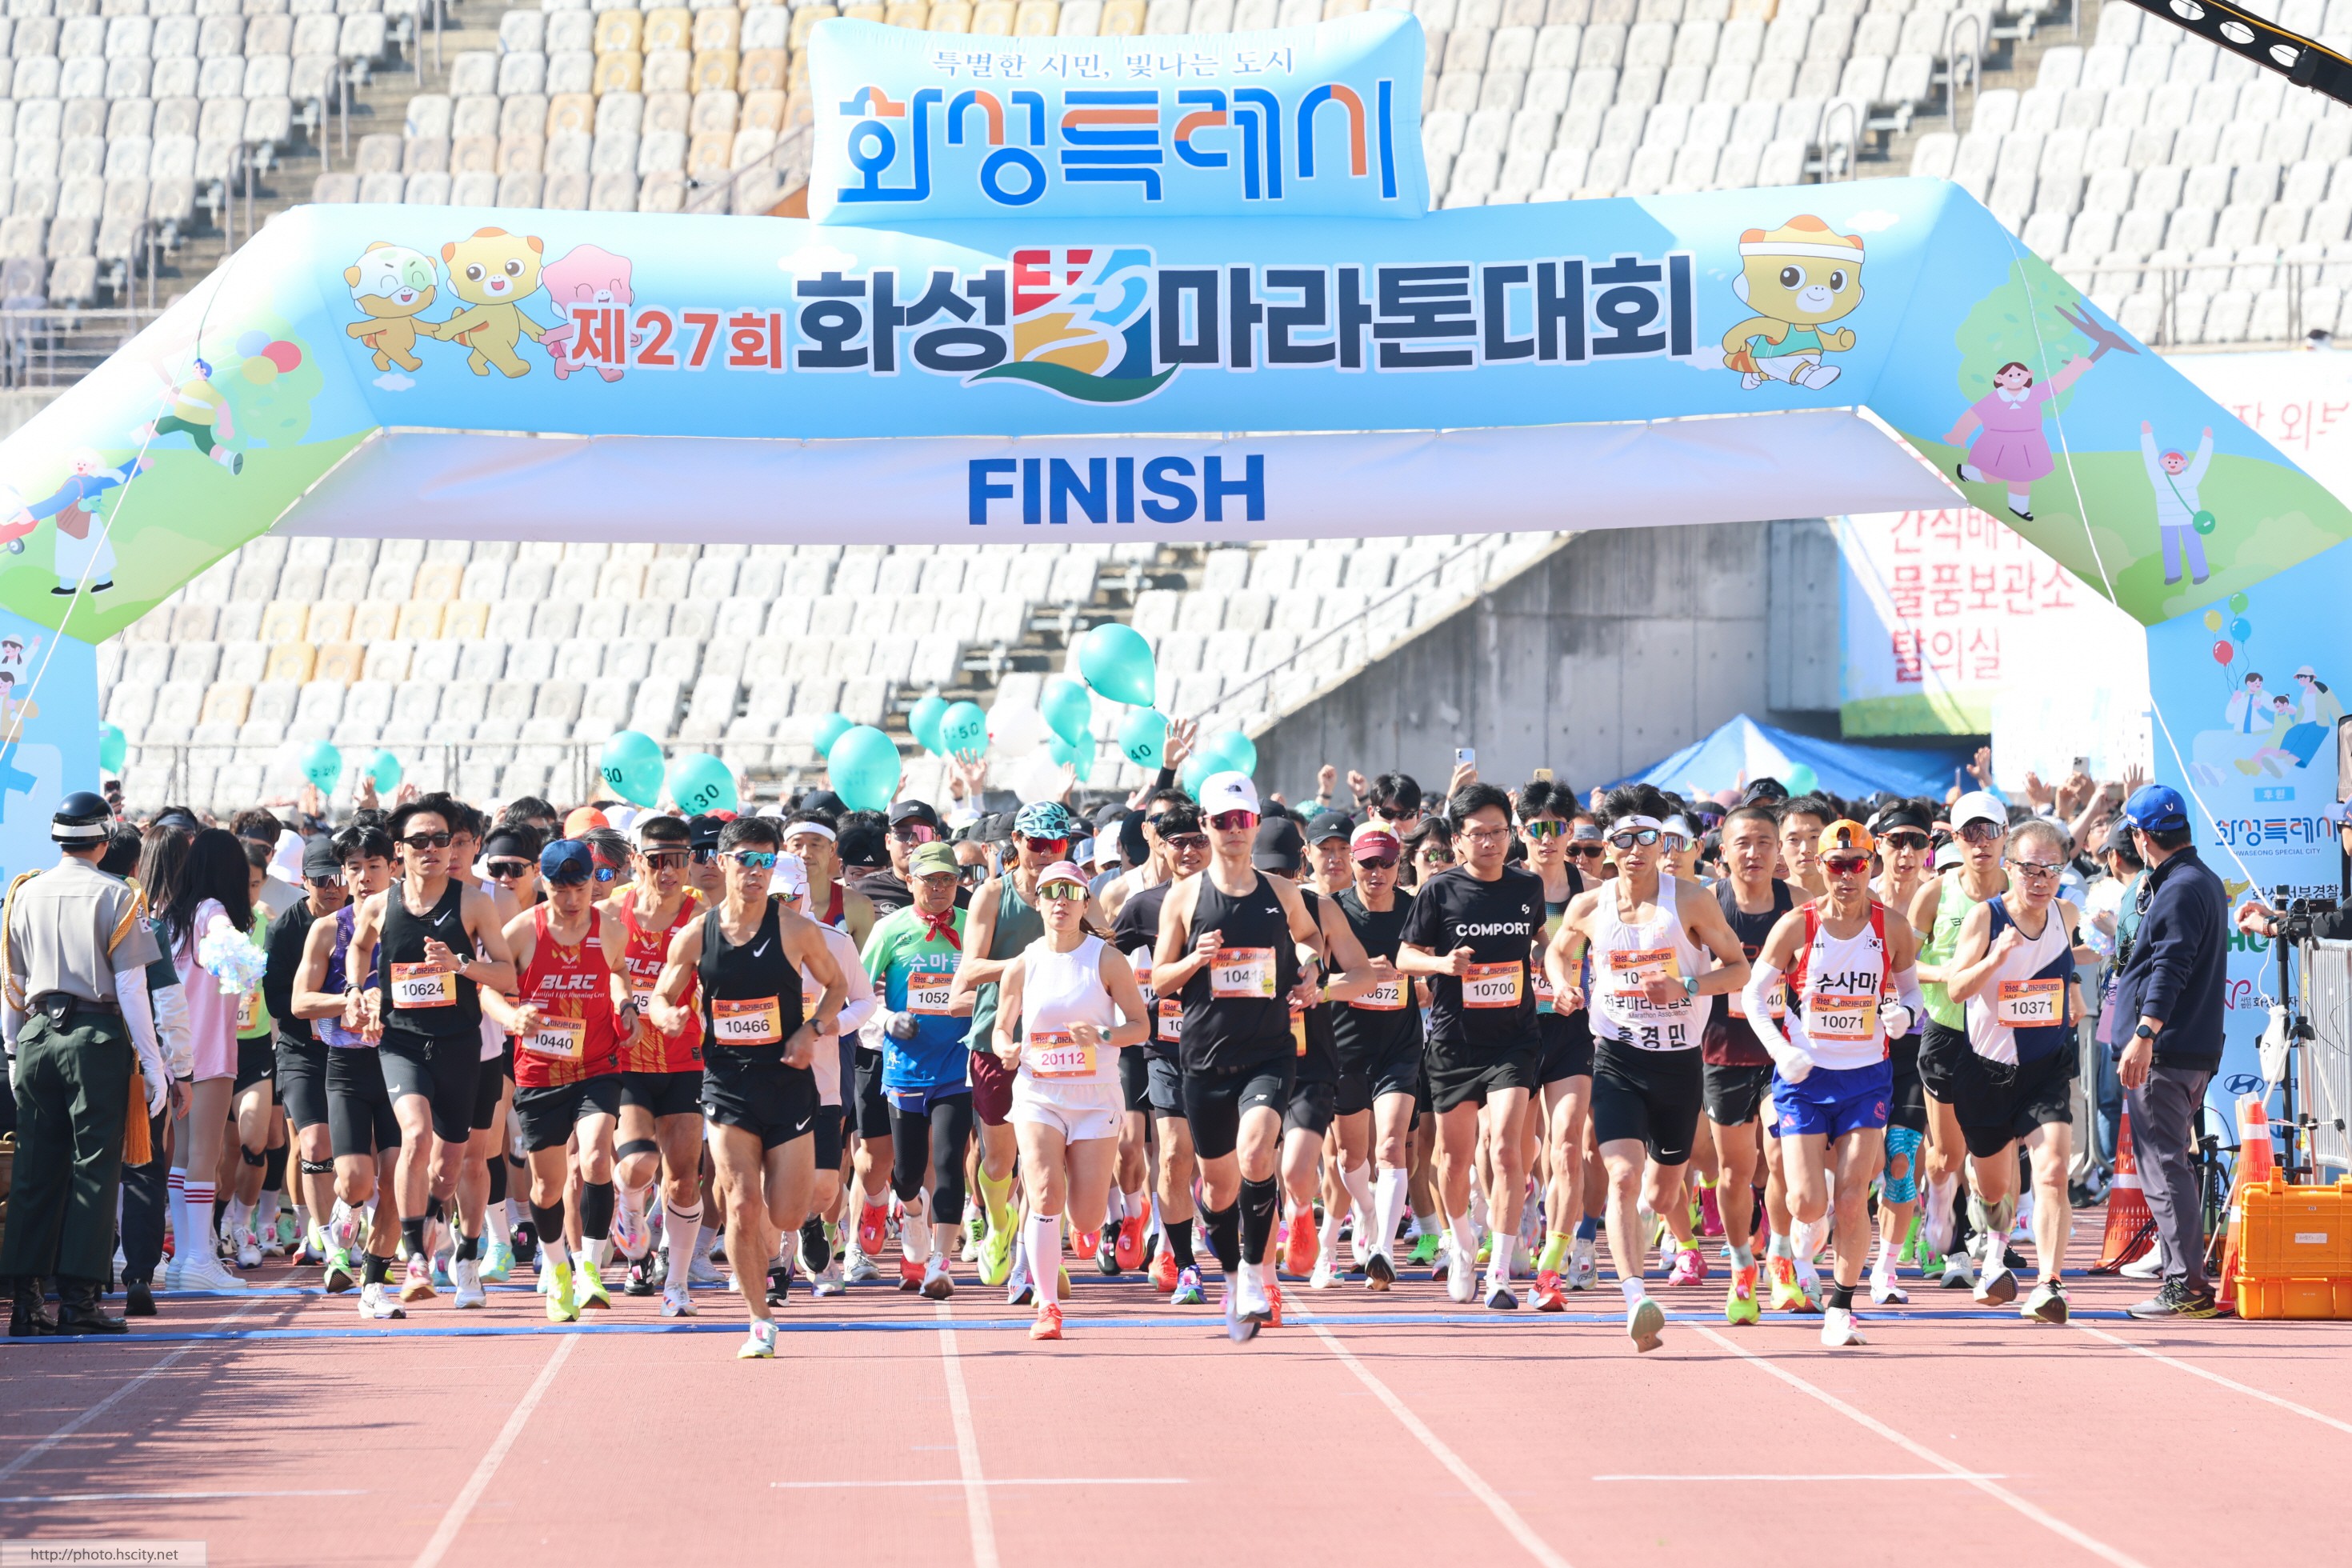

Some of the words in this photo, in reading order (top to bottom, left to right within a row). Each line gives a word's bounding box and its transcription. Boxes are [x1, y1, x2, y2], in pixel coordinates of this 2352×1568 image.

[932, 49, 1027, 79] 특별한
[1042, 52, 1112, 80] 시민,
[1126, 49, 1219, 78] 빛나는
[1233, 46, 1294, 74] 도시
[838, 80, 1398, 206] 화성특례시
[573, 307, 782, 369] 제27회
[969, 454, 1265, 525] FINISH
[1890, 560, 2074, 618] 물품보관소
[1892, 628, 2000, 683] 탈의실
[2263, 789, 2286, 799] 후원
[2214, 816, 2338, 847] 화성특례시
[1456, 922, 1530, 937] COMPORT
[624, 957, 666, 976] BLR
[402, 982, 445, 996] 10624
[540, 974, 598, 990] BLRC
[1473, 982, 1516, 996] 10700
[1816, 971, 1878, 994] 수사마
[1361, 987, 1399, 1000] 672
[2010, 1001, 2053, 1014] 10371
[725, 1019, 770, 1034] 10466
[1821, 1014, 1864, 1029] 10071
[534, 1034, 574, 1050] 10440
[1041, 1052, 1086, 1066] 20112
